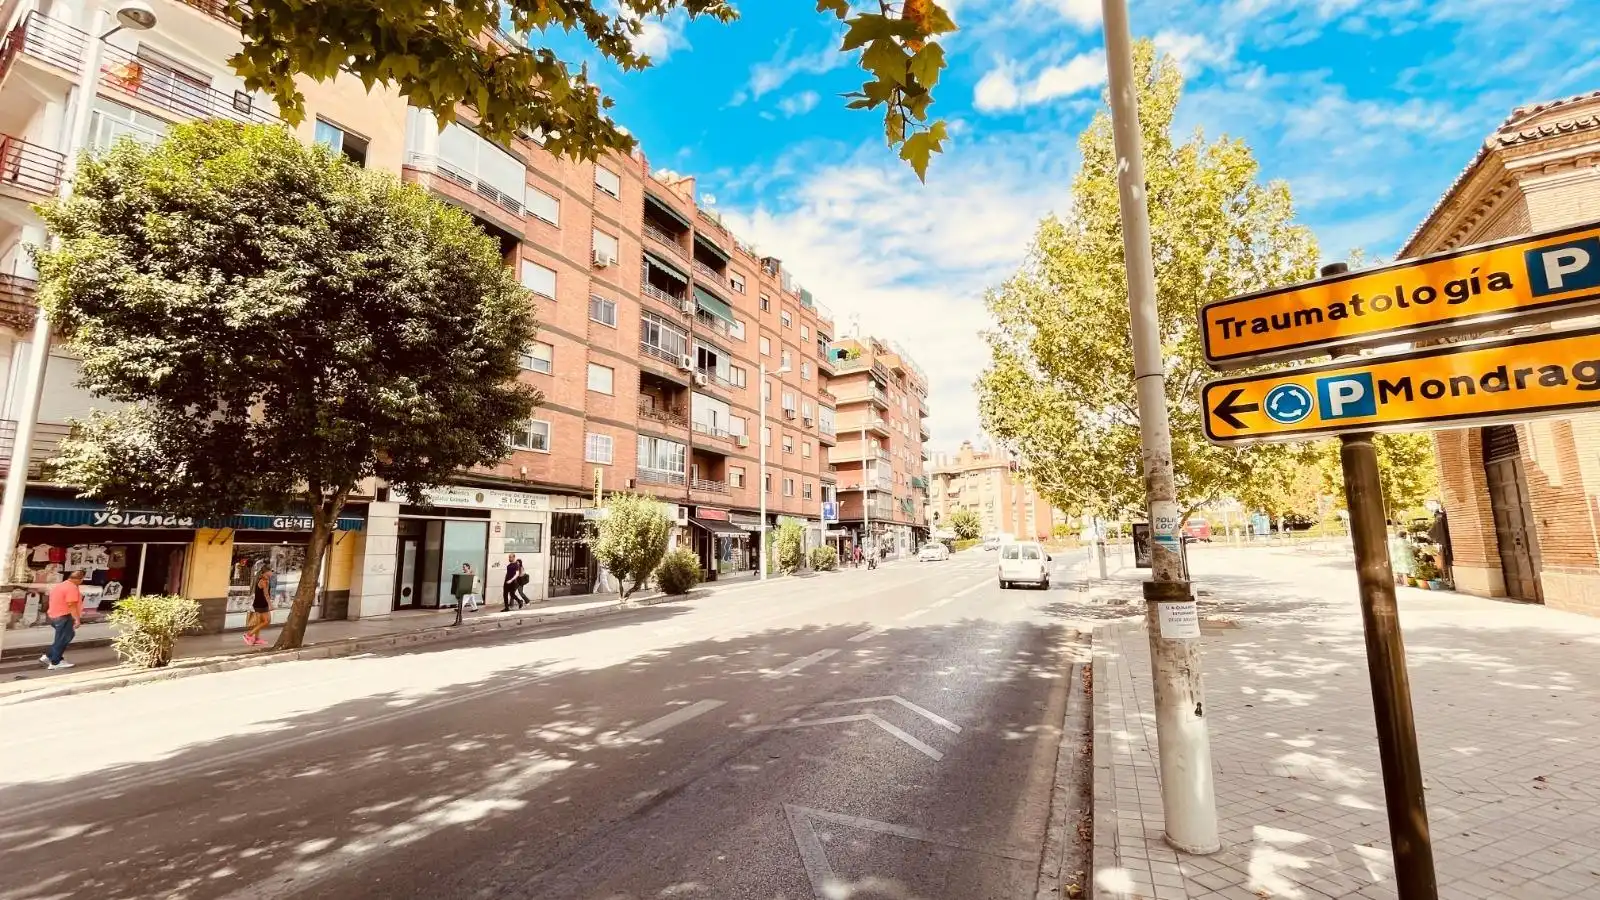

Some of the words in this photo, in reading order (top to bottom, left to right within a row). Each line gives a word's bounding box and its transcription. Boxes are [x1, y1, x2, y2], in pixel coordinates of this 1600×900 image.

[1215, 267, 1513, 339] Traumatología
[1542, 247, 1591, 290] P
[1330, 379, 1365, 416] P
[1378, 360, 1600, 404] Mondrag
[502, 497, 537, 506] SIMEG
